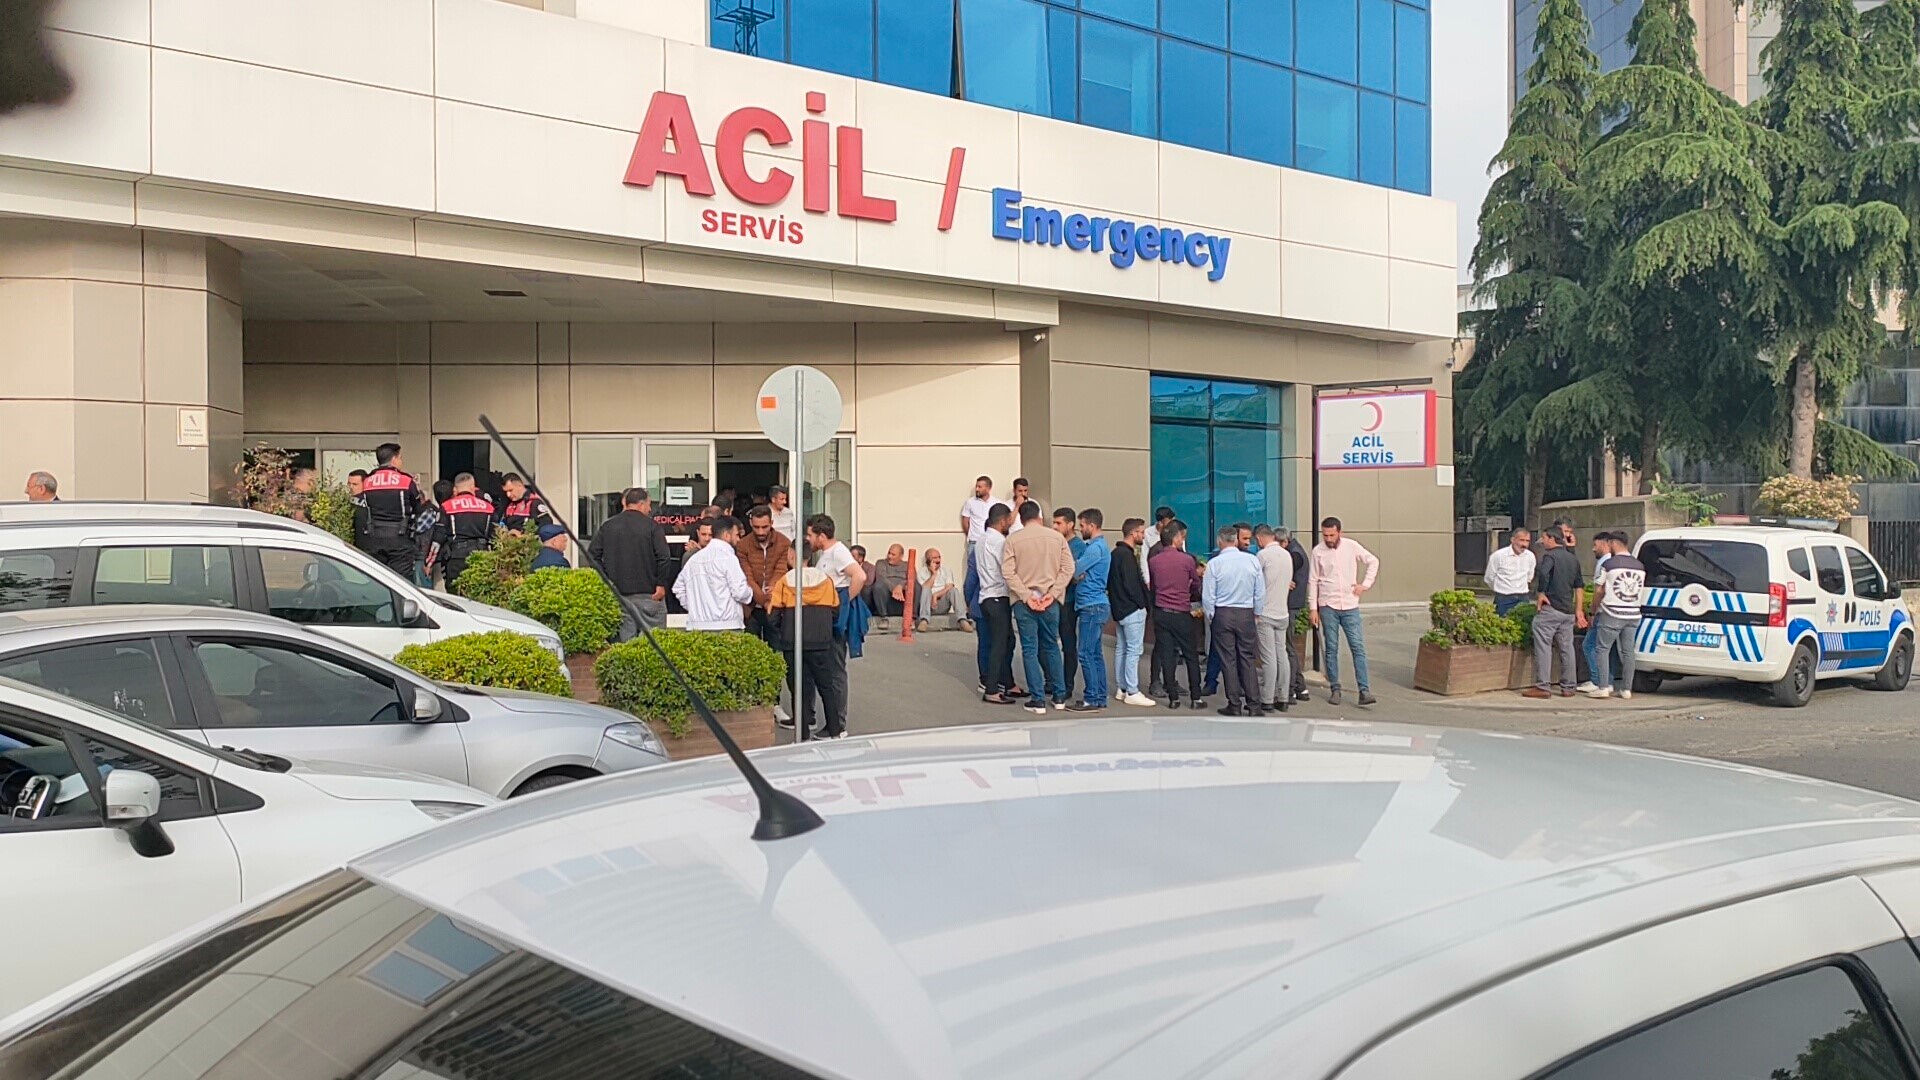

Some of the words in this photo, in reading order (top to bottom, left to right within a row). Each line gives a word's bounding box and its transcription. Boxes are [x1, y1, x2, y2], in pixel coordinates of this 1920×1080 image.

[622, 90, 897, 223] ACİL
[992, 187, 1231, 281] Emergency
[701, 209, 803, 245] SERVİS
[1352, 433, 1384, 448] ACİL
[1343, 450, 1394, 464] SERVİS
